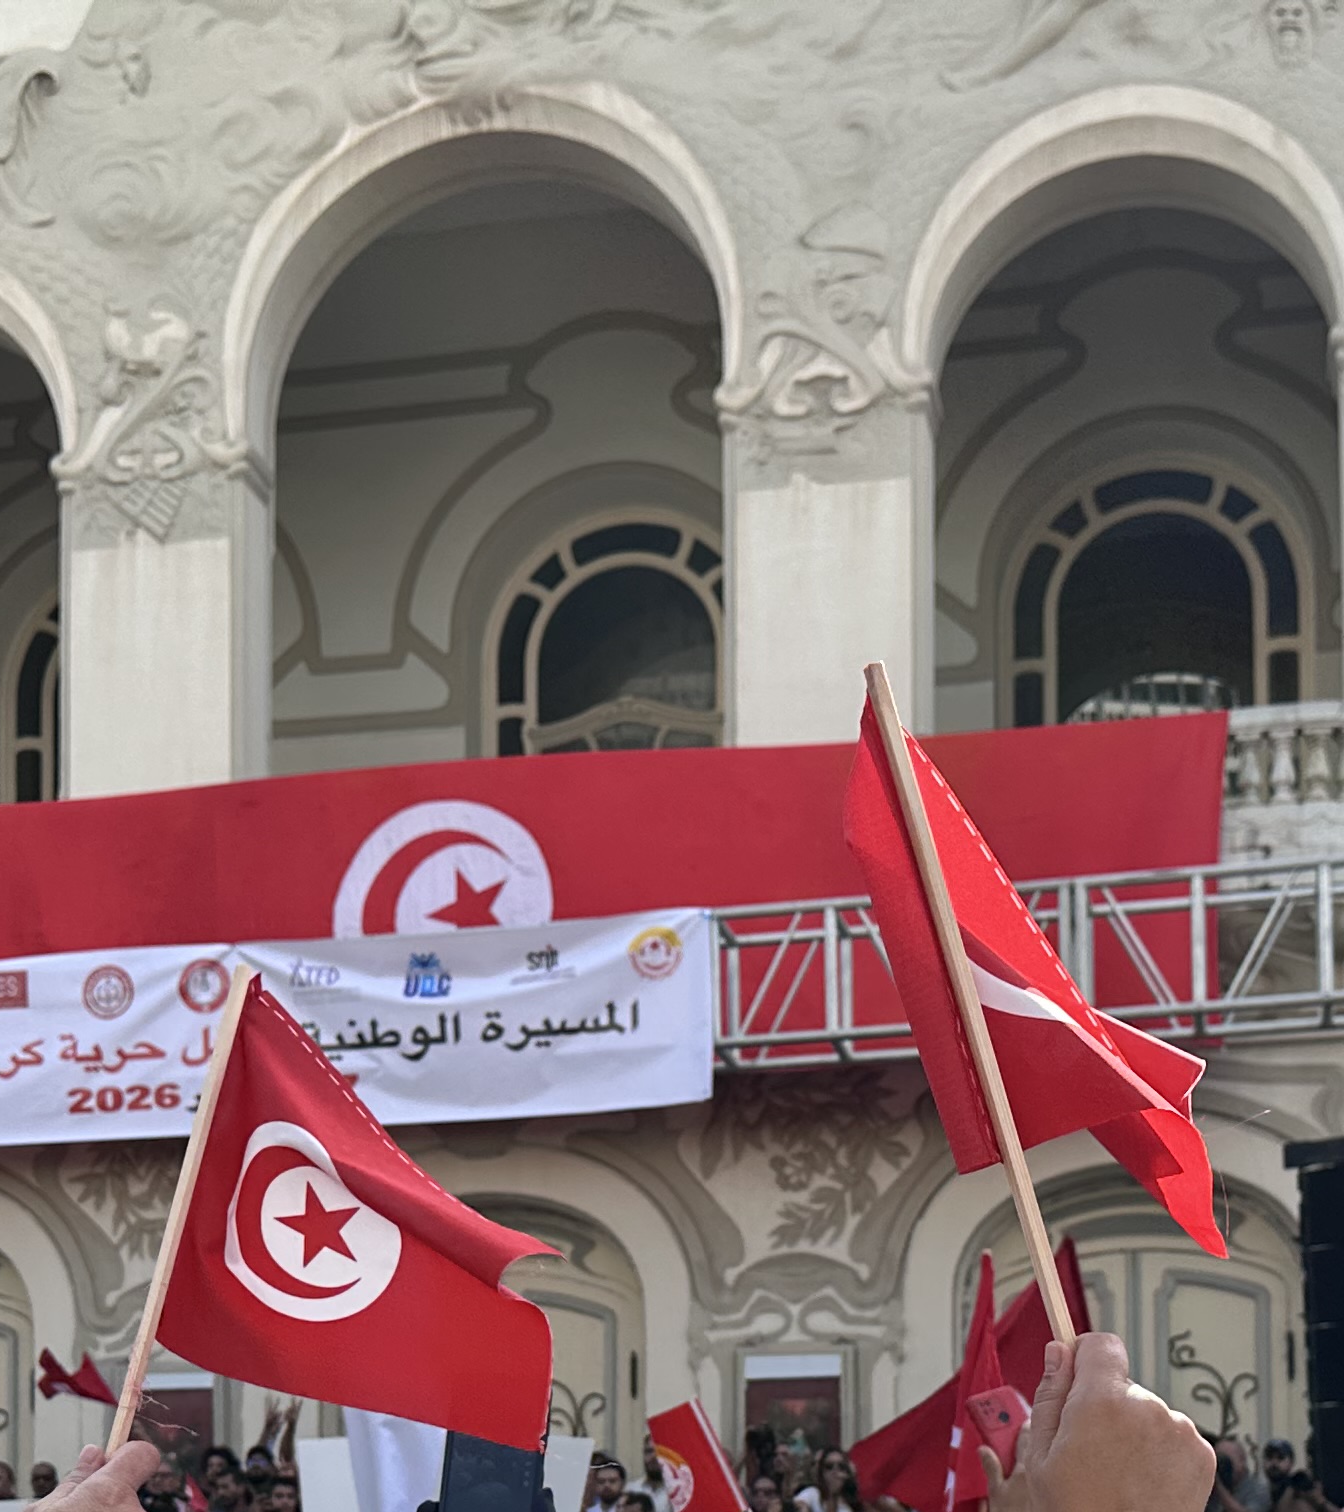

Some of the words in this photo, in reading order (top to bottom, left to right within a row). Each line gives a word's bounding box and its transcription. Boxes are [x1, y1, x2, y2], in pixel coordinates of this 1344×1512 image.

[481, 999, 640, 1051] المسيرة
[59, 1033, 167, 1073] حرية
[67, 1081, 182, 1115] 2026
